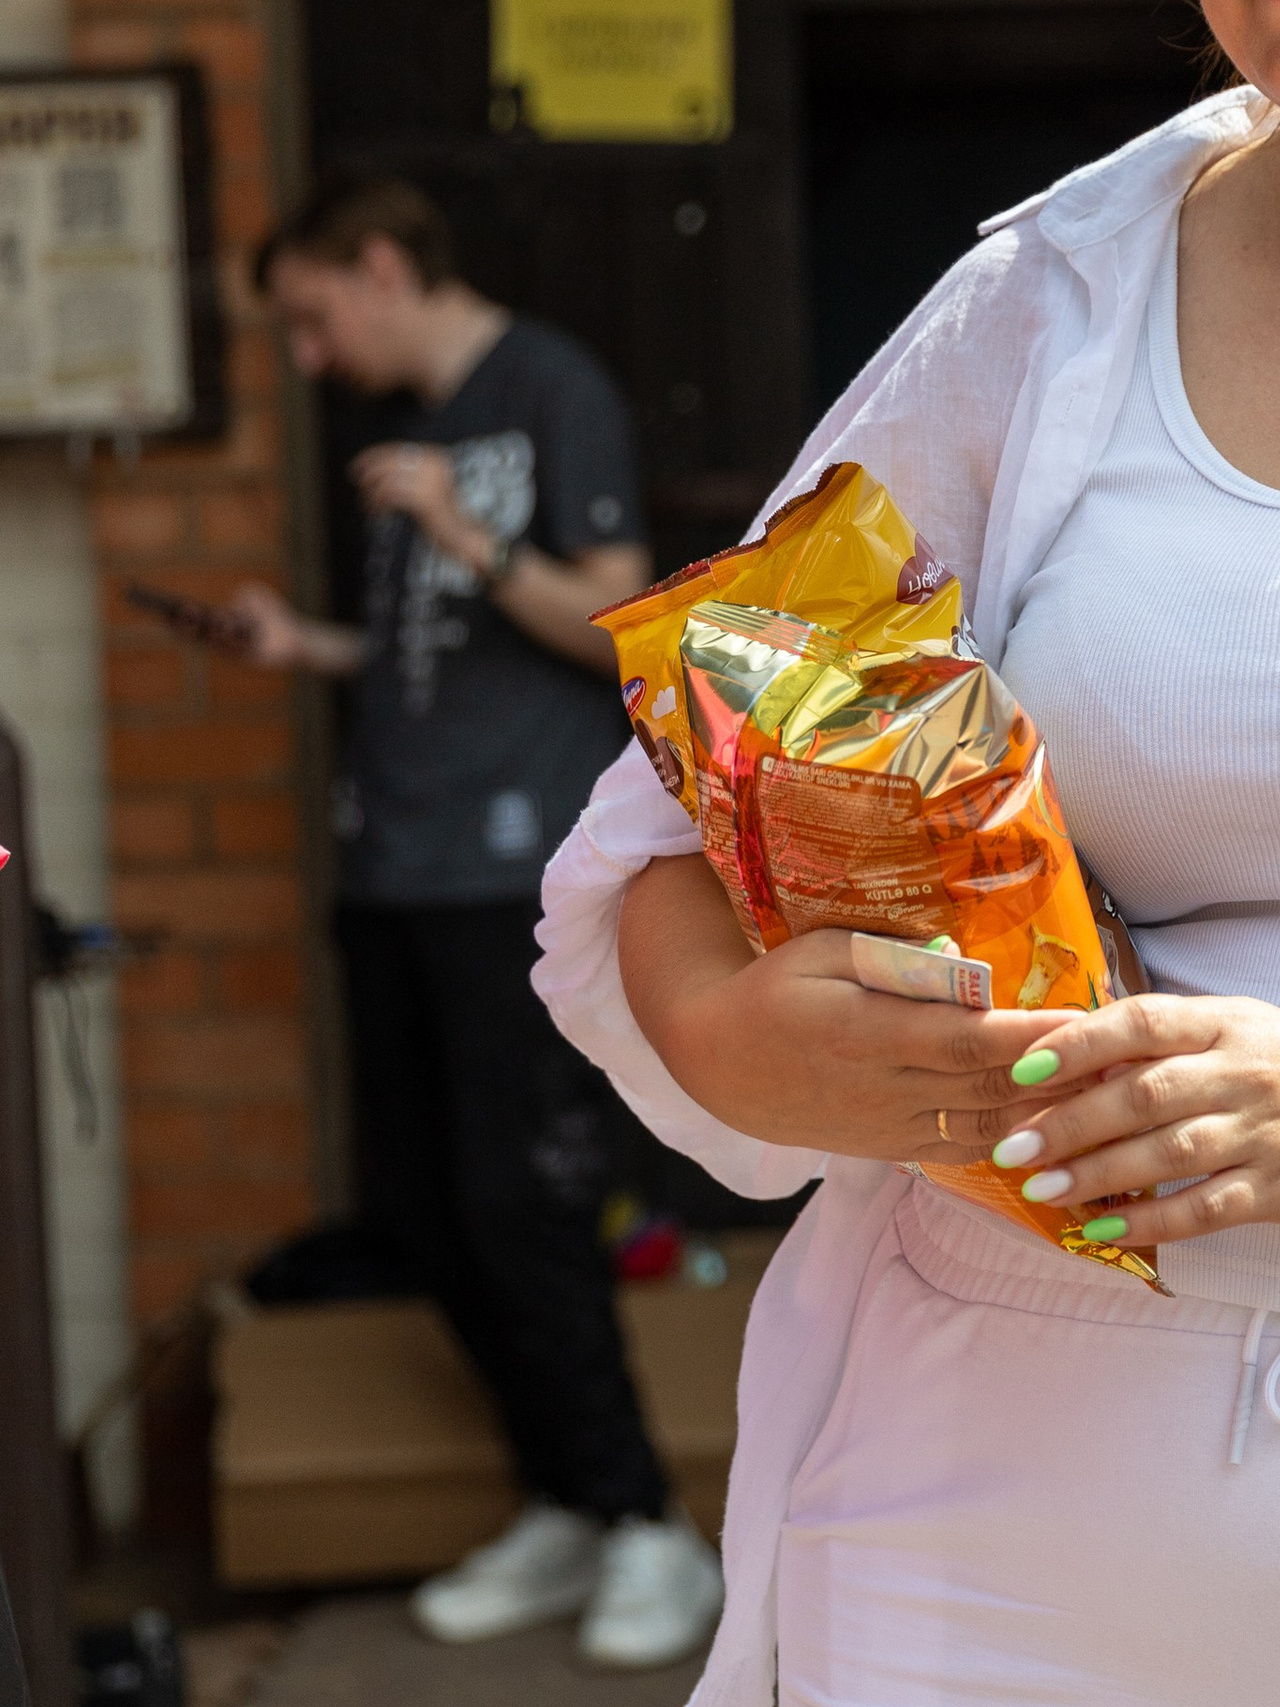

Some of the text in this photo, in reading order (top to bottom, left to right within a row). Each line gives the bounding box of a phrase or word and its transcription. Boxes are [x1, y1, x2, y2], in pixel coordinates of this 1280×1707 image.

[865, 884, 933, 901] KÜTLƏ 80 Q
